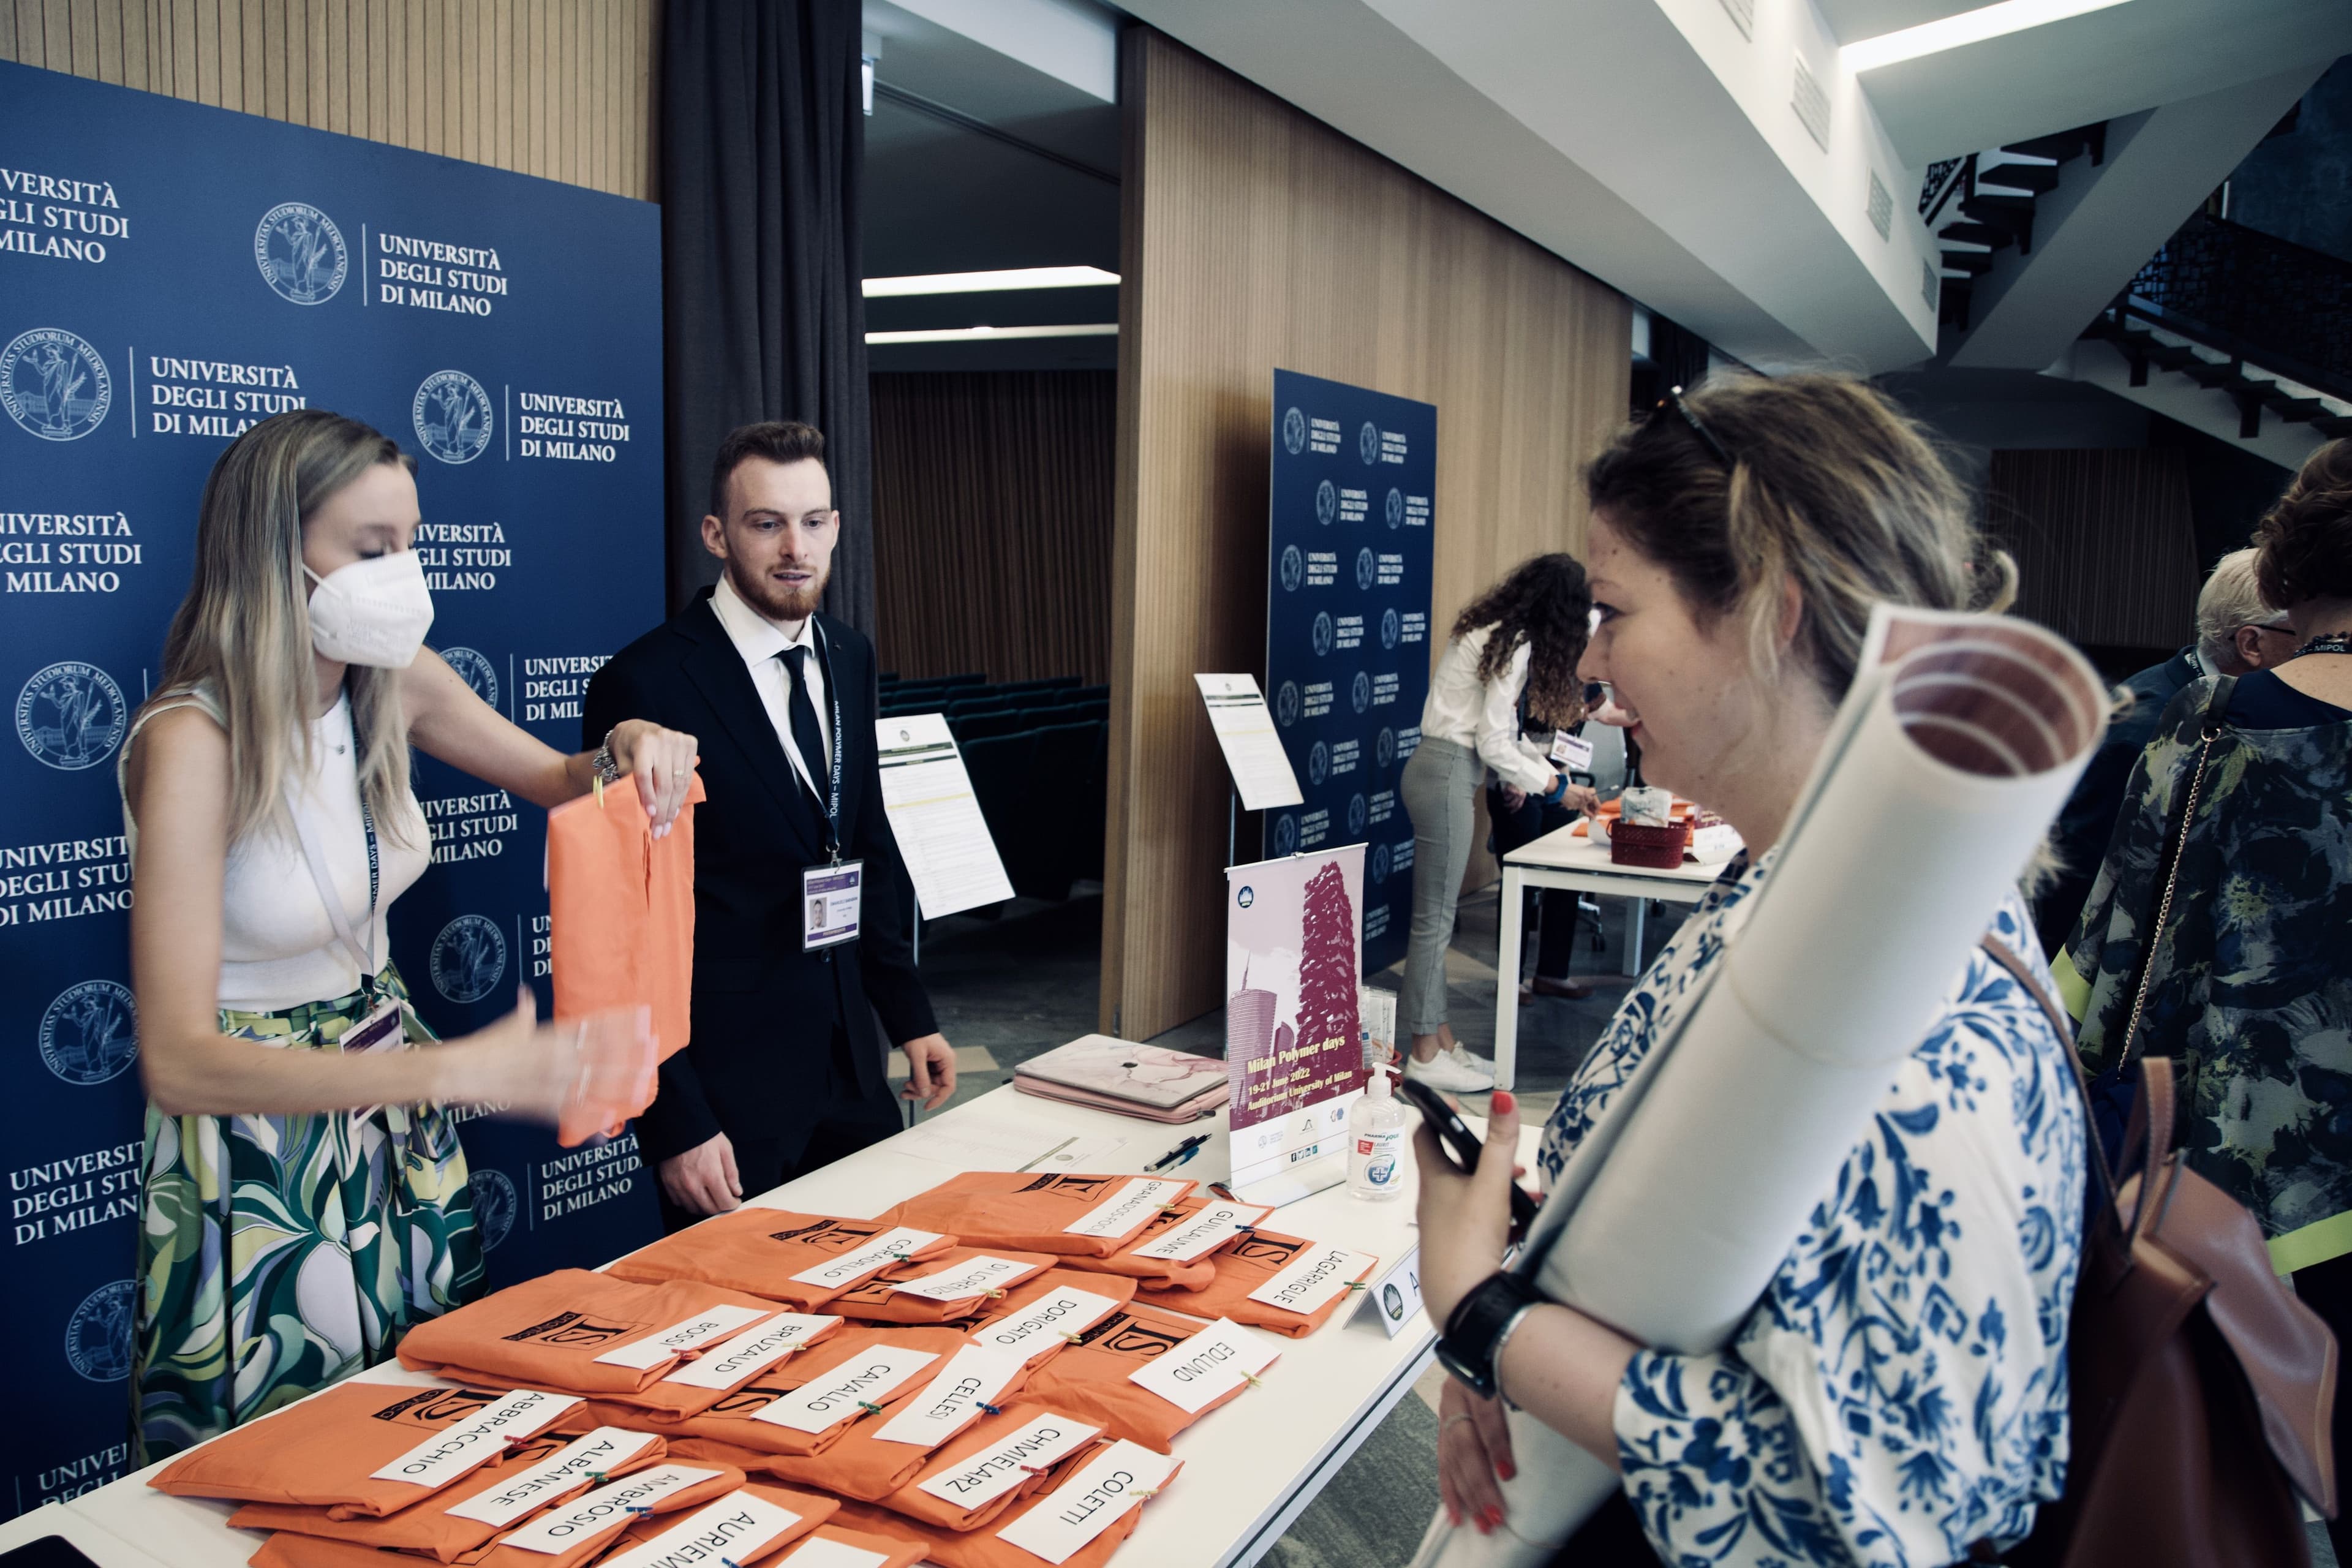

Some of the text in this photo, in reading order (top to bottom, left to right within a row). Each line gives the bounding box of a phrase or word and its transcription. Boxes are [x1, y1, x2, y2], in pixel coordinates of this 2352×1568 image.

[0, 168, 120, 209] VERSITÀ
[44, 206, 129, 239] STUDI
[379, 233, 501, 271] UNIVERSITÀ
[380, 259, 508, 296] DEGLI STUDI
[381, 284, 491, 317] DI MILANO
[151, 355, 300, 389] UNIVERSITÀ
[152, 384, 229, 410] DEGLI
[519, 392, 625, 420] UNIVERSITÀ
[153, 412, 182, 434] DI
[520, 416, 630, 442] DEGLI STUDI
[521, 440, 616, 462] DI MILANO
[59, 543, 142, 564] STUDI
[453, 549, 511, 567] STUDI
[6, 571, 120, 593] MILANO
[2314, 644, 2346, 652] MIPOL
[526, 680, 578, 699] DEGLI
[526, 702, 583, 722] DI MIL
[832, 764, 841, 785] DAYS
[829, 792, 840, 819] MIPOL
[461, 814, 518, 837] STUDI
[28, 889, 134, 923] MILANO
[1247, 1036, 1346, 1074] Milan Polymer days
[1248, 1068, 1311, 1096] 19-21 June 2022
[1289, 1079, 1324, 1097] University
[1325, 1074, 1333, 1085] of
[1333, 1071, 1352, 1083] Milan
[541, 1133, 639, 1179] UNIVERSITÀ
[12, 1180, 94, 1219] DEGLI
[543, 1172, 592, 1200] DEGLI
[543, 1178, 633, 1221] DI MILANO
[15, 1195, 138, 1246] DI MILAN
[1084, 1180, 1162, 1235] GRANADOS-FOCIL
[1155, 1210, 1234, 1254] GUILLAUME
[824, 1238, 912, 1279] CORADELLO
[1273, 1250, 1349, 1304] LAGARRIGUE
[659, 1322, 719, 1347] BOSSI
[995, 1299, 1077, 1345] DORIGATO
[715, 1324, 802, 1373] BRUZAUD
[1173, 1341, 1235, 1383] EDLUND
[807, 1364, 891, 1412] CAVALLO
[925, 1378, 982, 1420] CELLESI
[402, 1392, 545, 1475] ABBRACCHIO
[490, 1440, 614, 1507] ALBANESE
[944, 1428, 1061, 1493] CHMIELARZ
[548, 1473, 680, 1537] AMBROSIO
[1058, 1470, 1134, 1526] COLETTI
